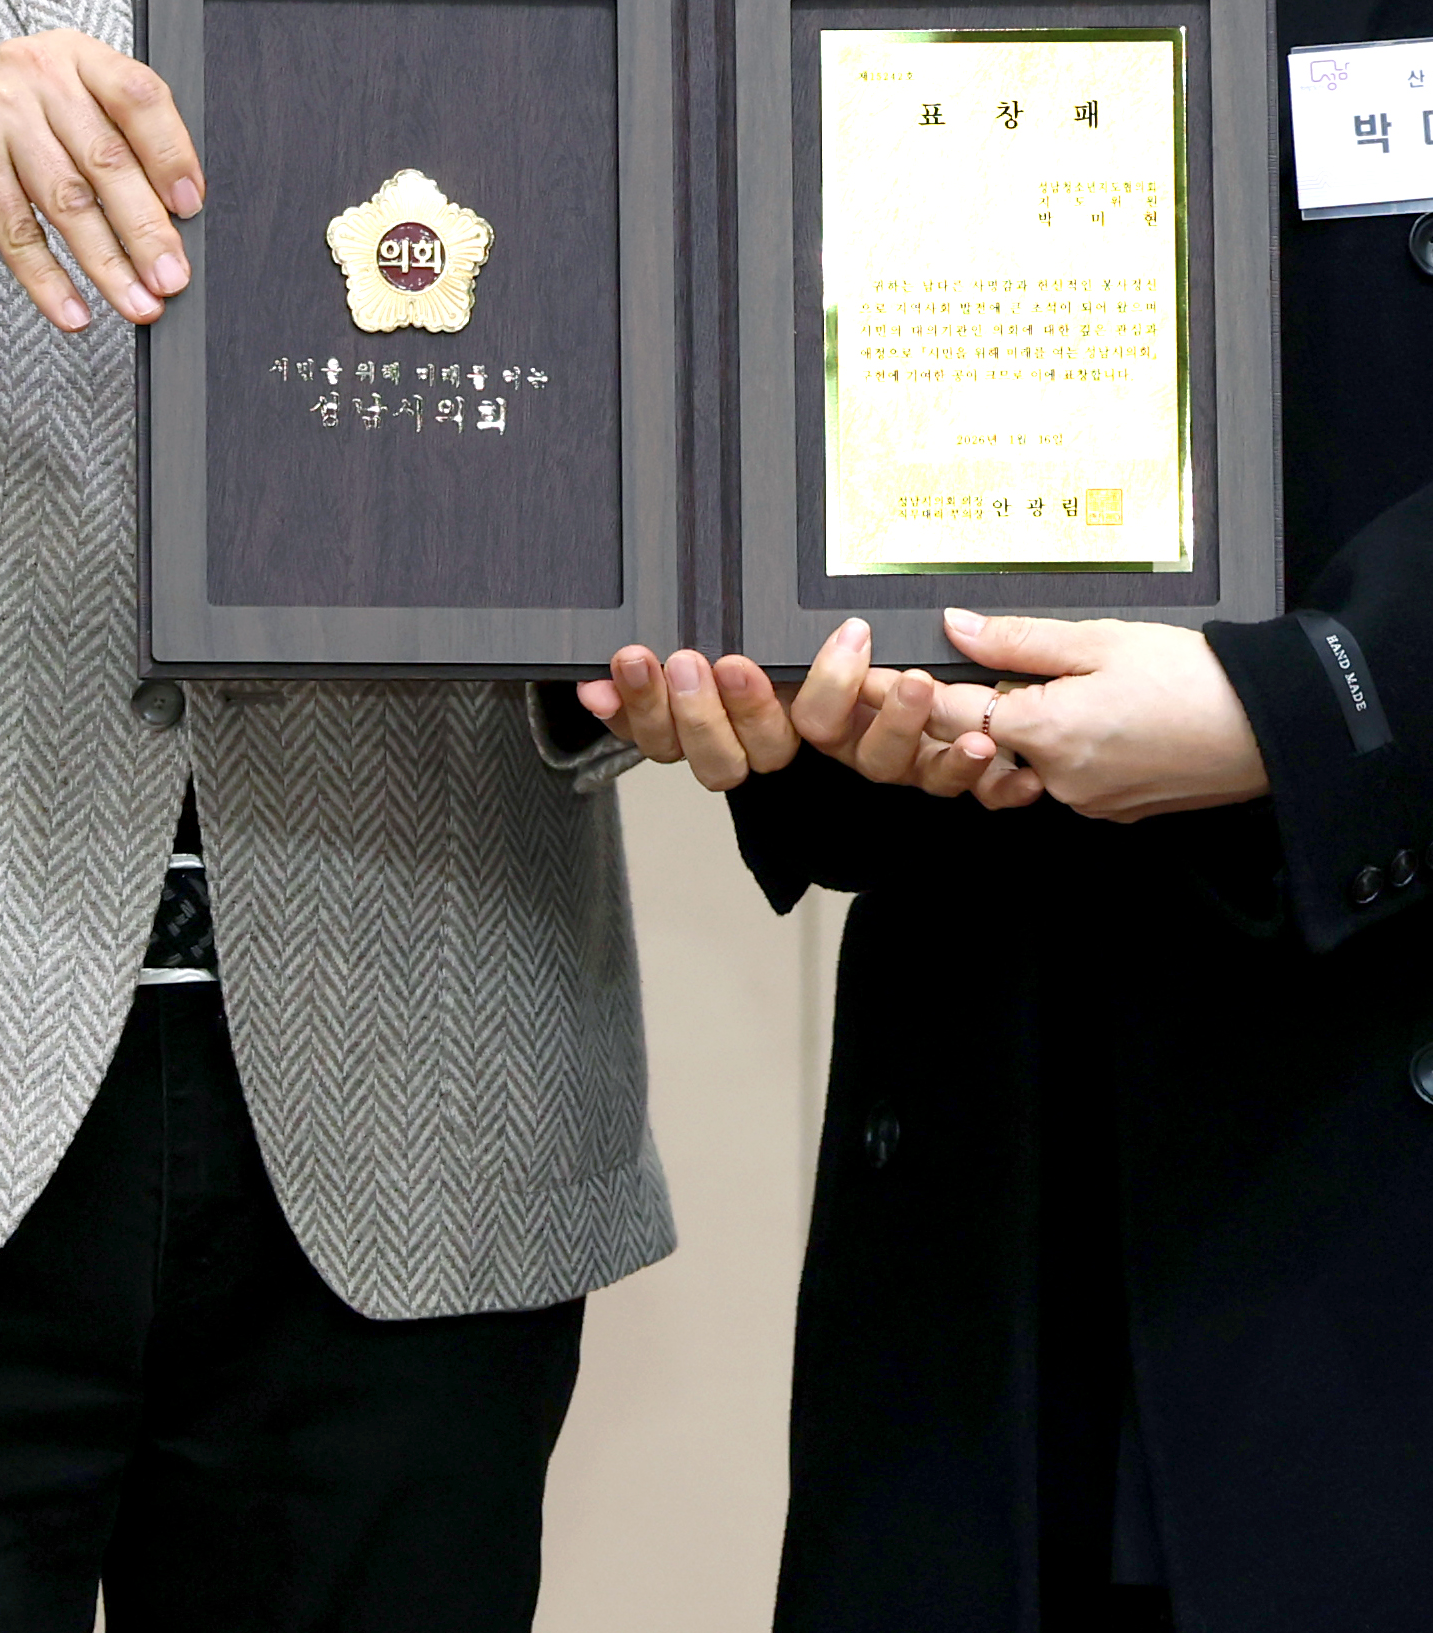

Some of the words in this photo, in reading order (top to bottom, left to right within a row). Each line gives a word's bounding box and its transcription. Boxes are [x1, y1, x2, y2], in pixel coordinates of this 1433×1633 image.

[379, 238, 442, 274] 의회
[1326, 634, 1351, 670] HAND
[1344, 672, 1367, 712] MADE
